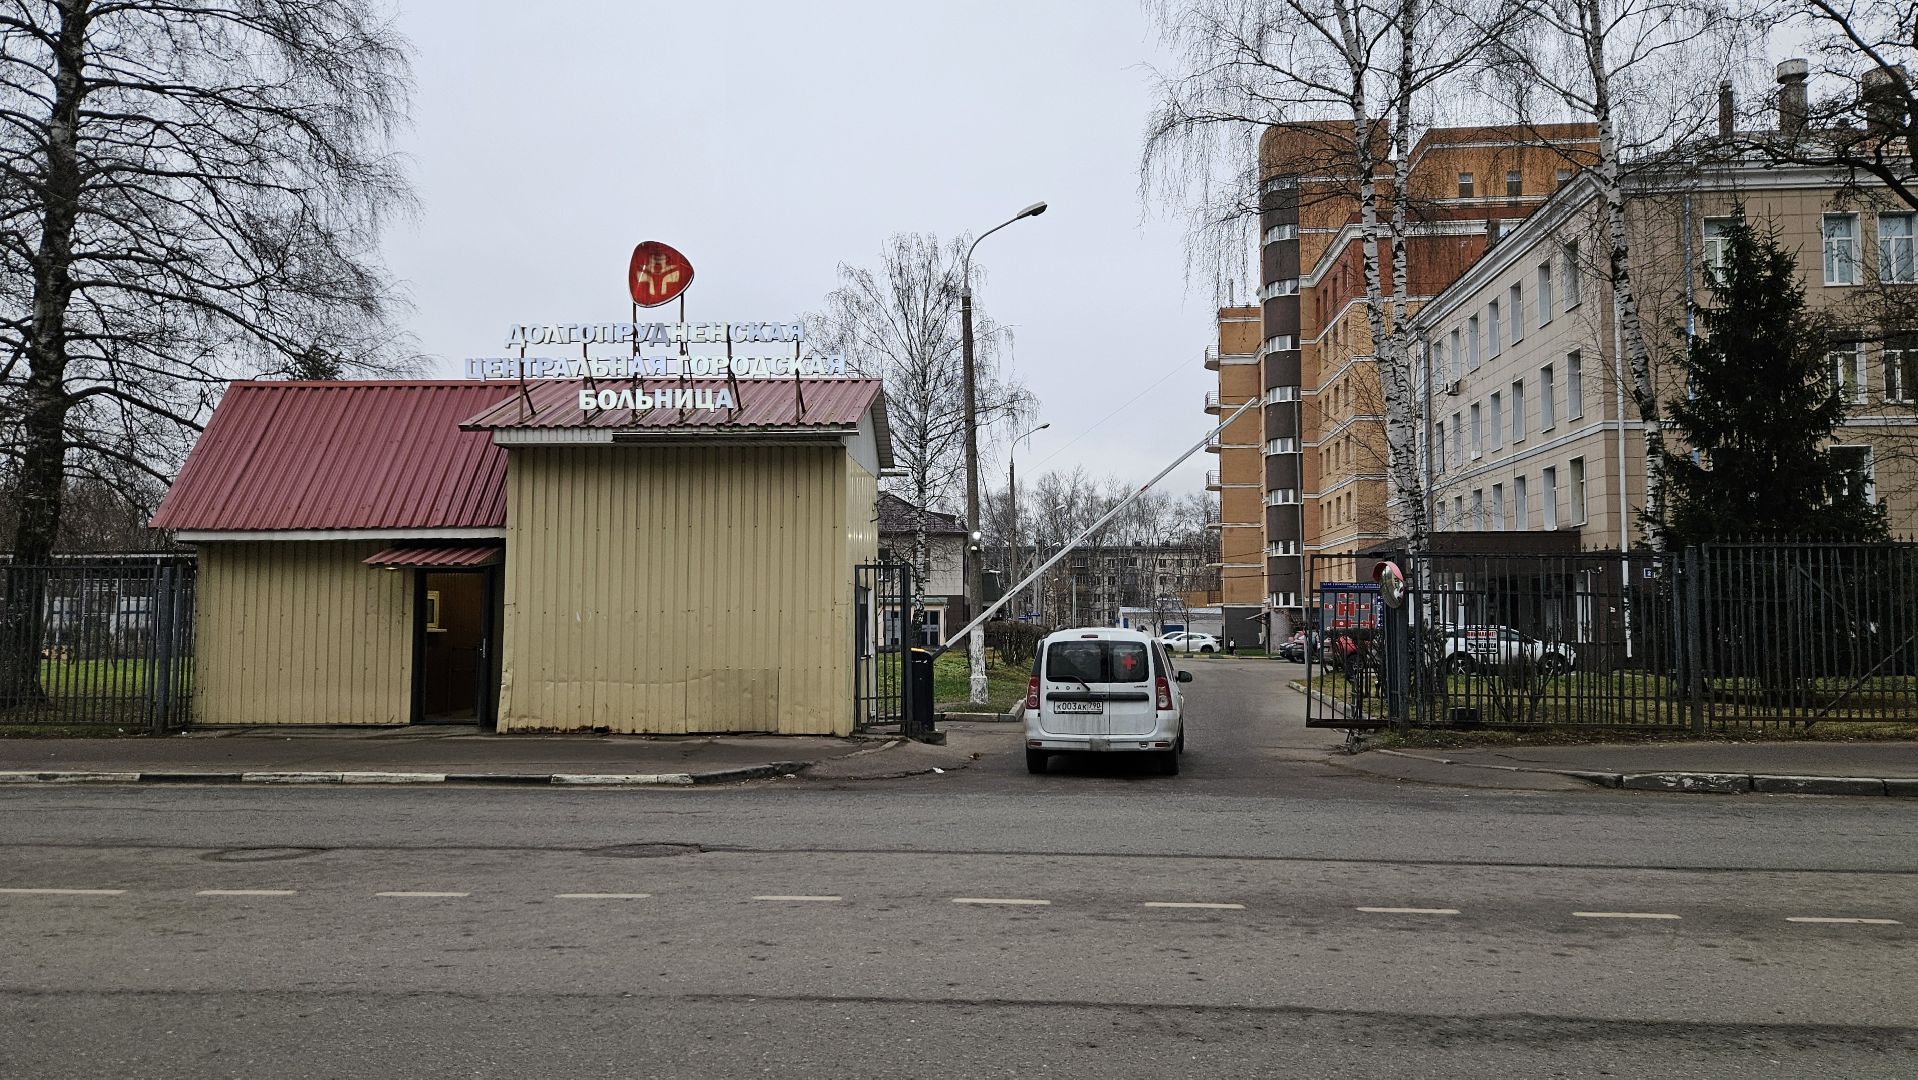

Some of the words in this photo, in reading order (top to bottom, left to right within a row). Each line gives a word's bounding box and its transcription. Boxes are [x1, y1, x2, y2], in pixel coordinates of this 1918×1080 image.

[505, 321, 805, 349] ДОЛГОПРУДНЕНСКАЯ
[465, 355, 667, 382] ЦЕНТРАЛЬНАЯ
[677, 355, 846, 380] ГОРОДСКАЯ
[579, 388, 734, 413] БОЛЬНИЦА
